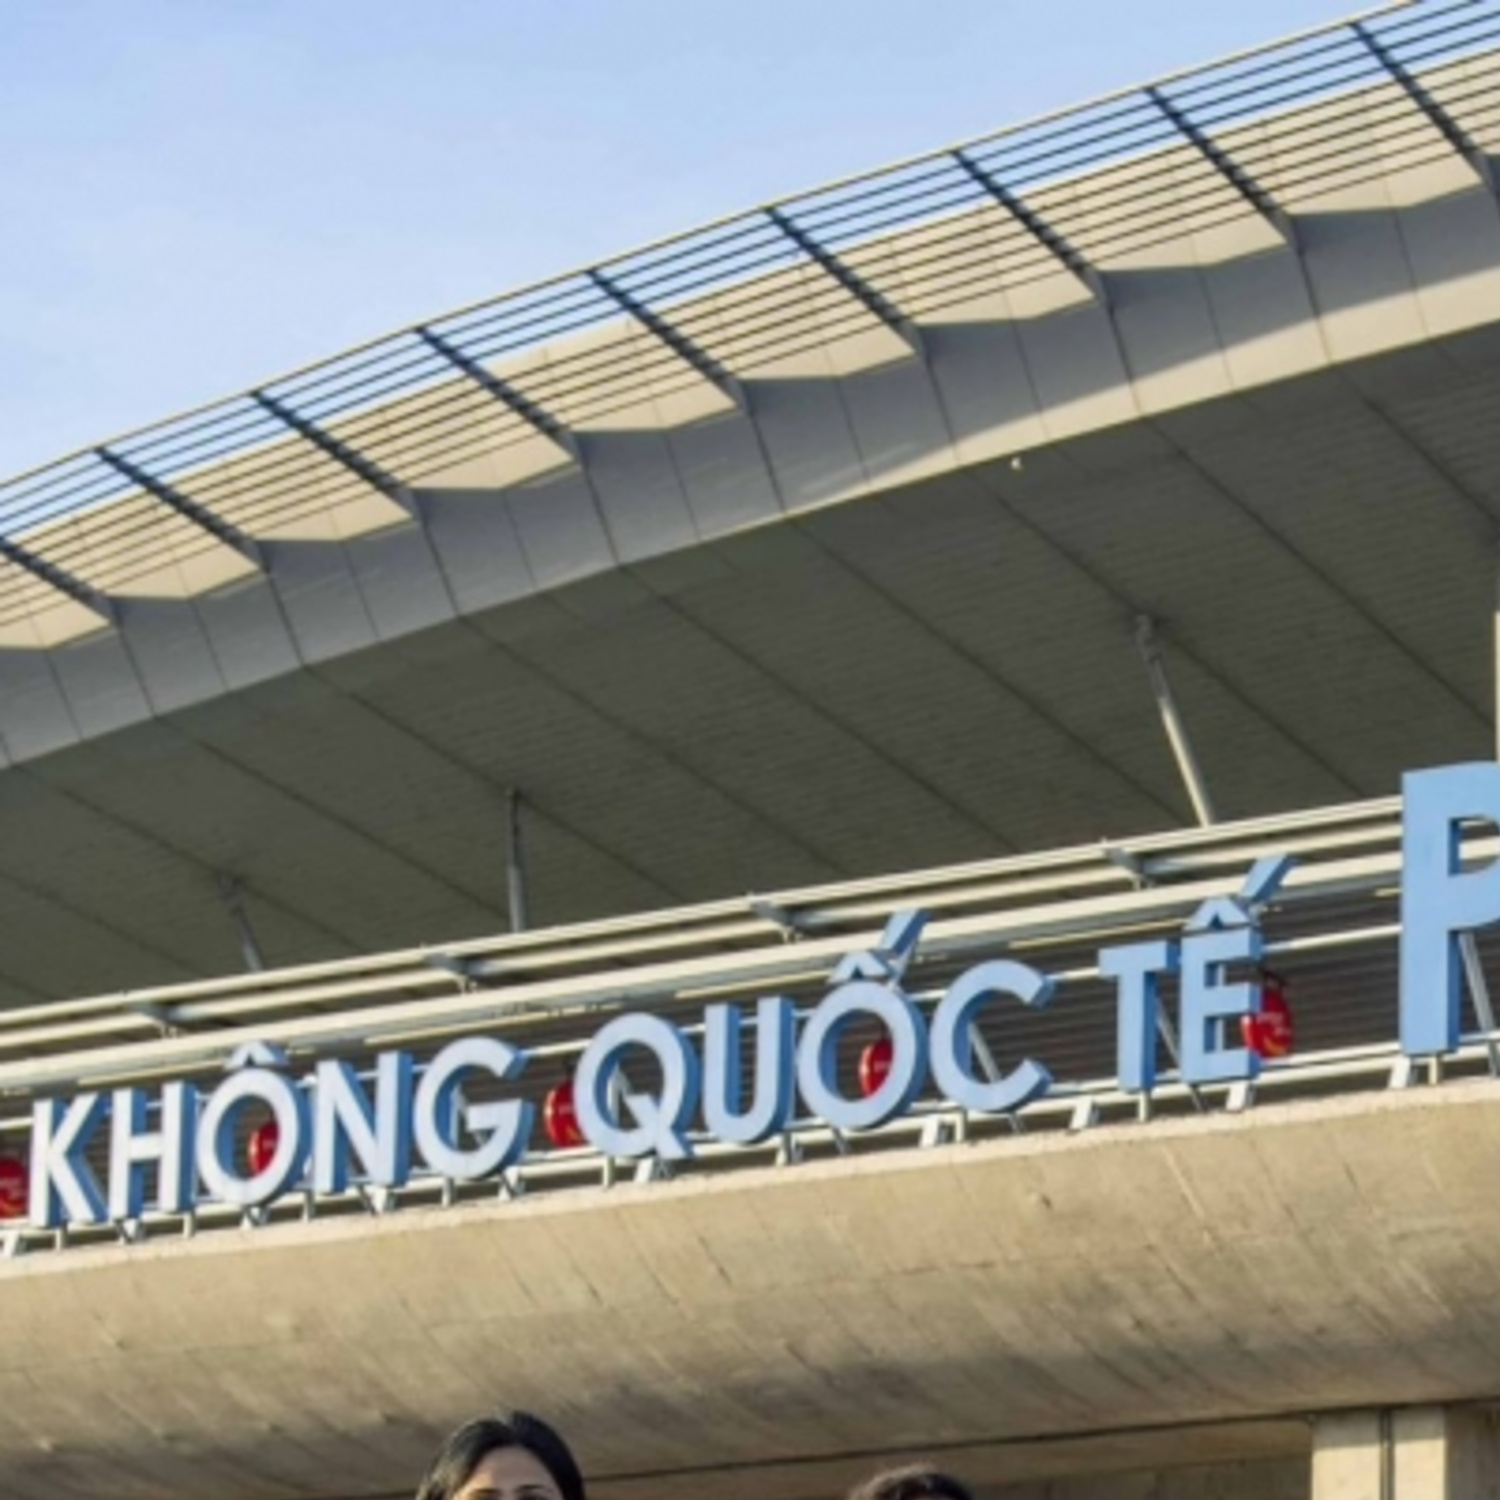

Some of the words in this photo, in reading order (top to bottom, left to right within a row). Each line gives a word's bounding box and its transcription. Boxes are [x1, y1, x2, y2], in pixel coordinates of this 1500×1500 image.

[29, 1037, 535, 1228] KHÔNG
[573, 907, 1055, 1160] QUỐC
[1098, 853, 1296, 1093] TẾ
